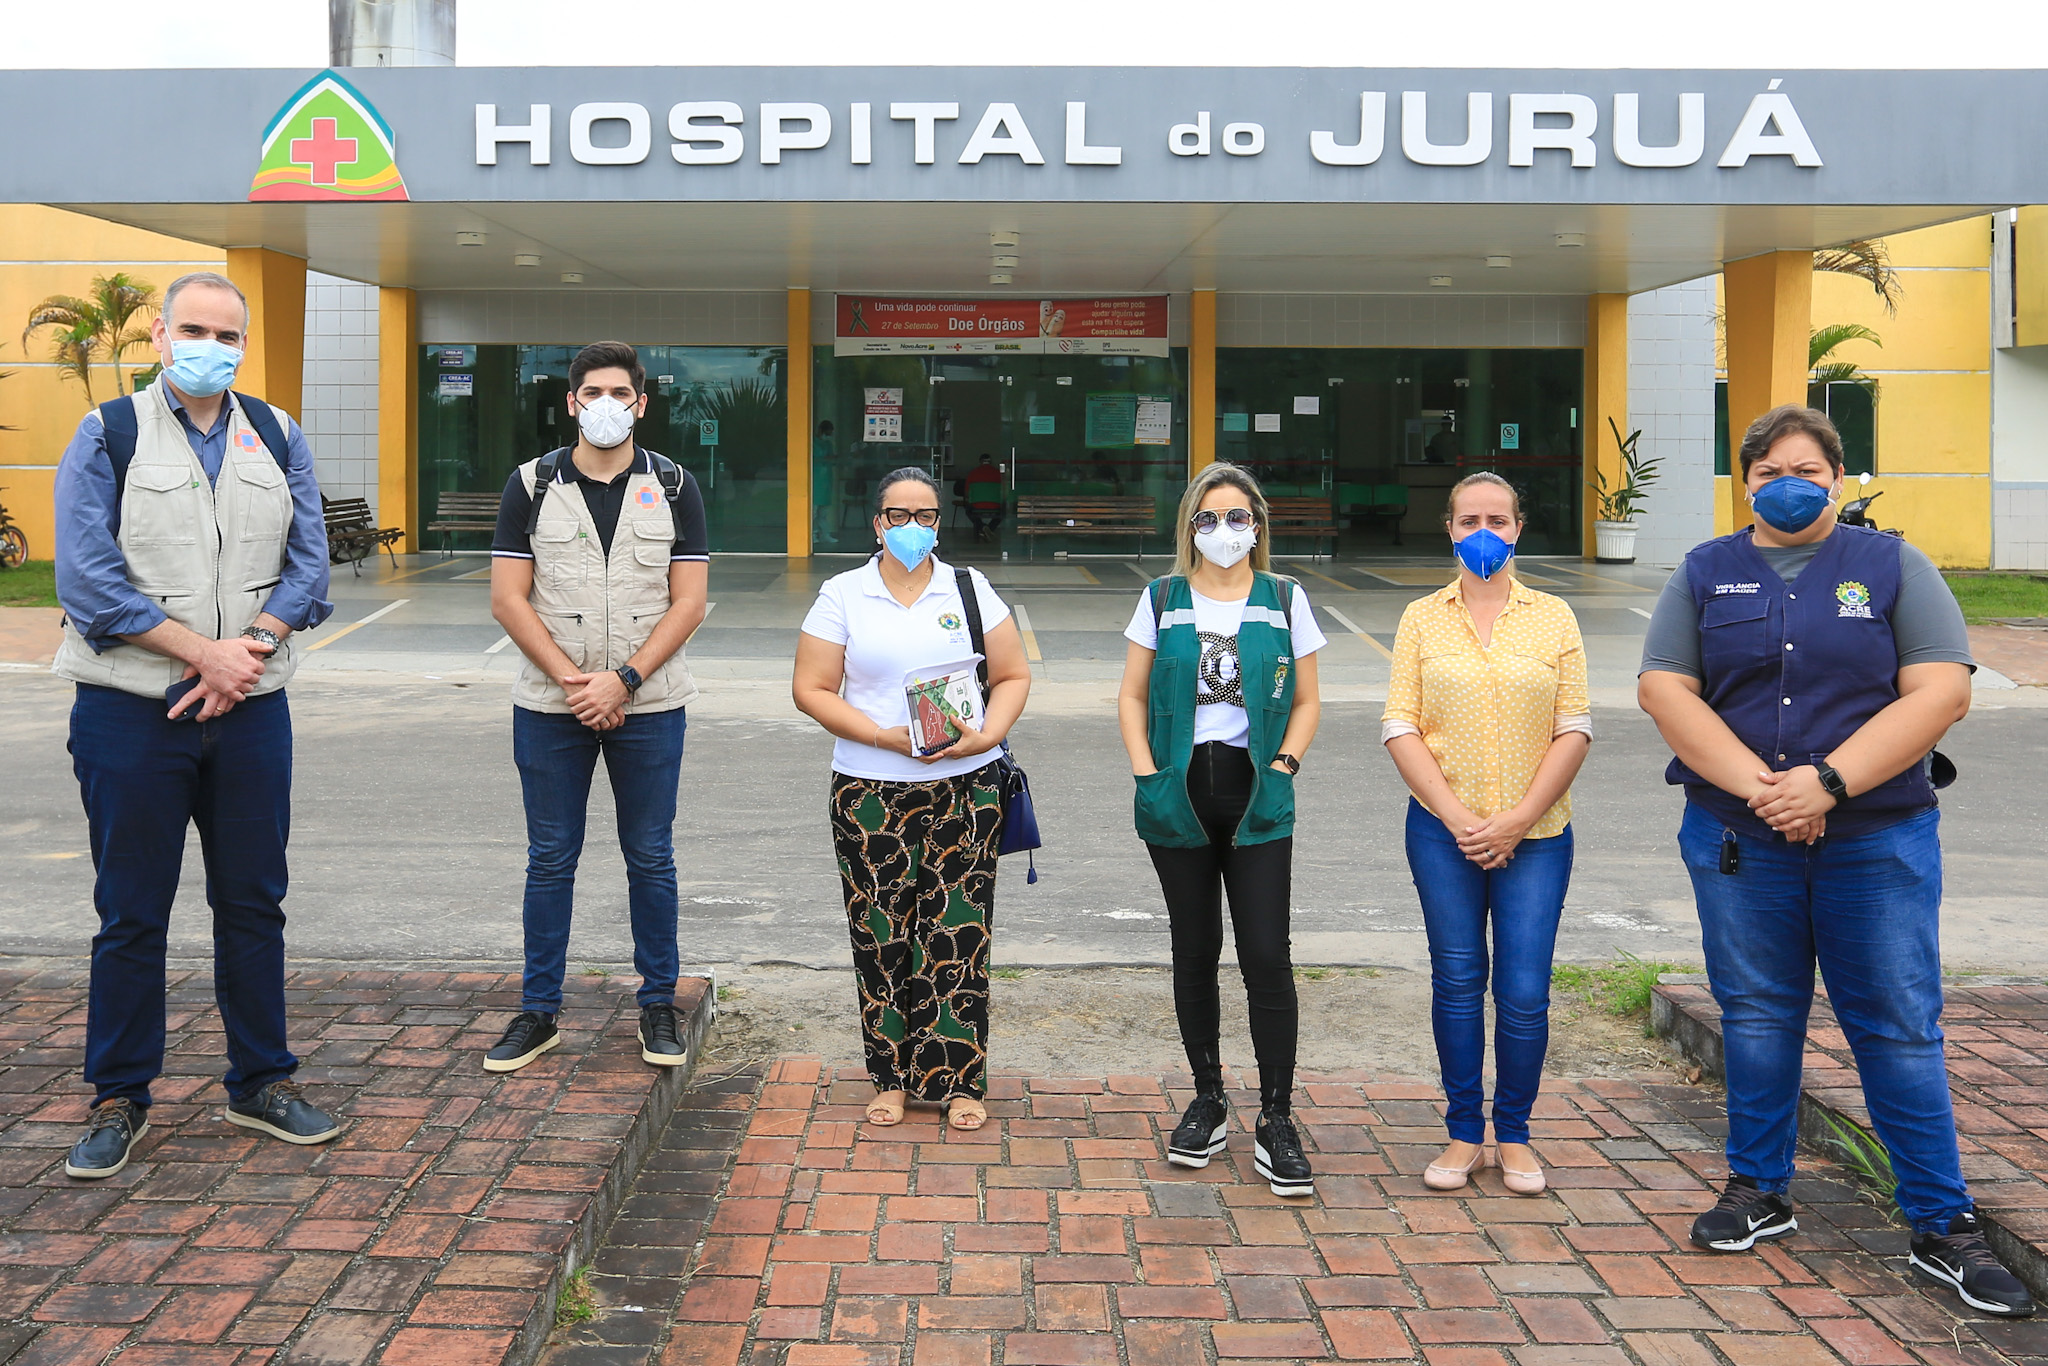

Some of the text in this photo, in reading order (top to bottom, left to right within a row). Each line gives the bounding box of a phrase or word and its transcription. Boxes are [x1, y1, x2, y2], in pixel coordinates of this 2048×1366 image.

[475, 78, 1824, 168] HOSPITAL do JURUÁ
[875, 302, 977, 314] Uma vida pode continuar
[881, 321, 939, 330] 27 de Setembro
[949, 313, 1025, 334] Doe Órgãos
[1838, 605, 1871, 613] ACRE
